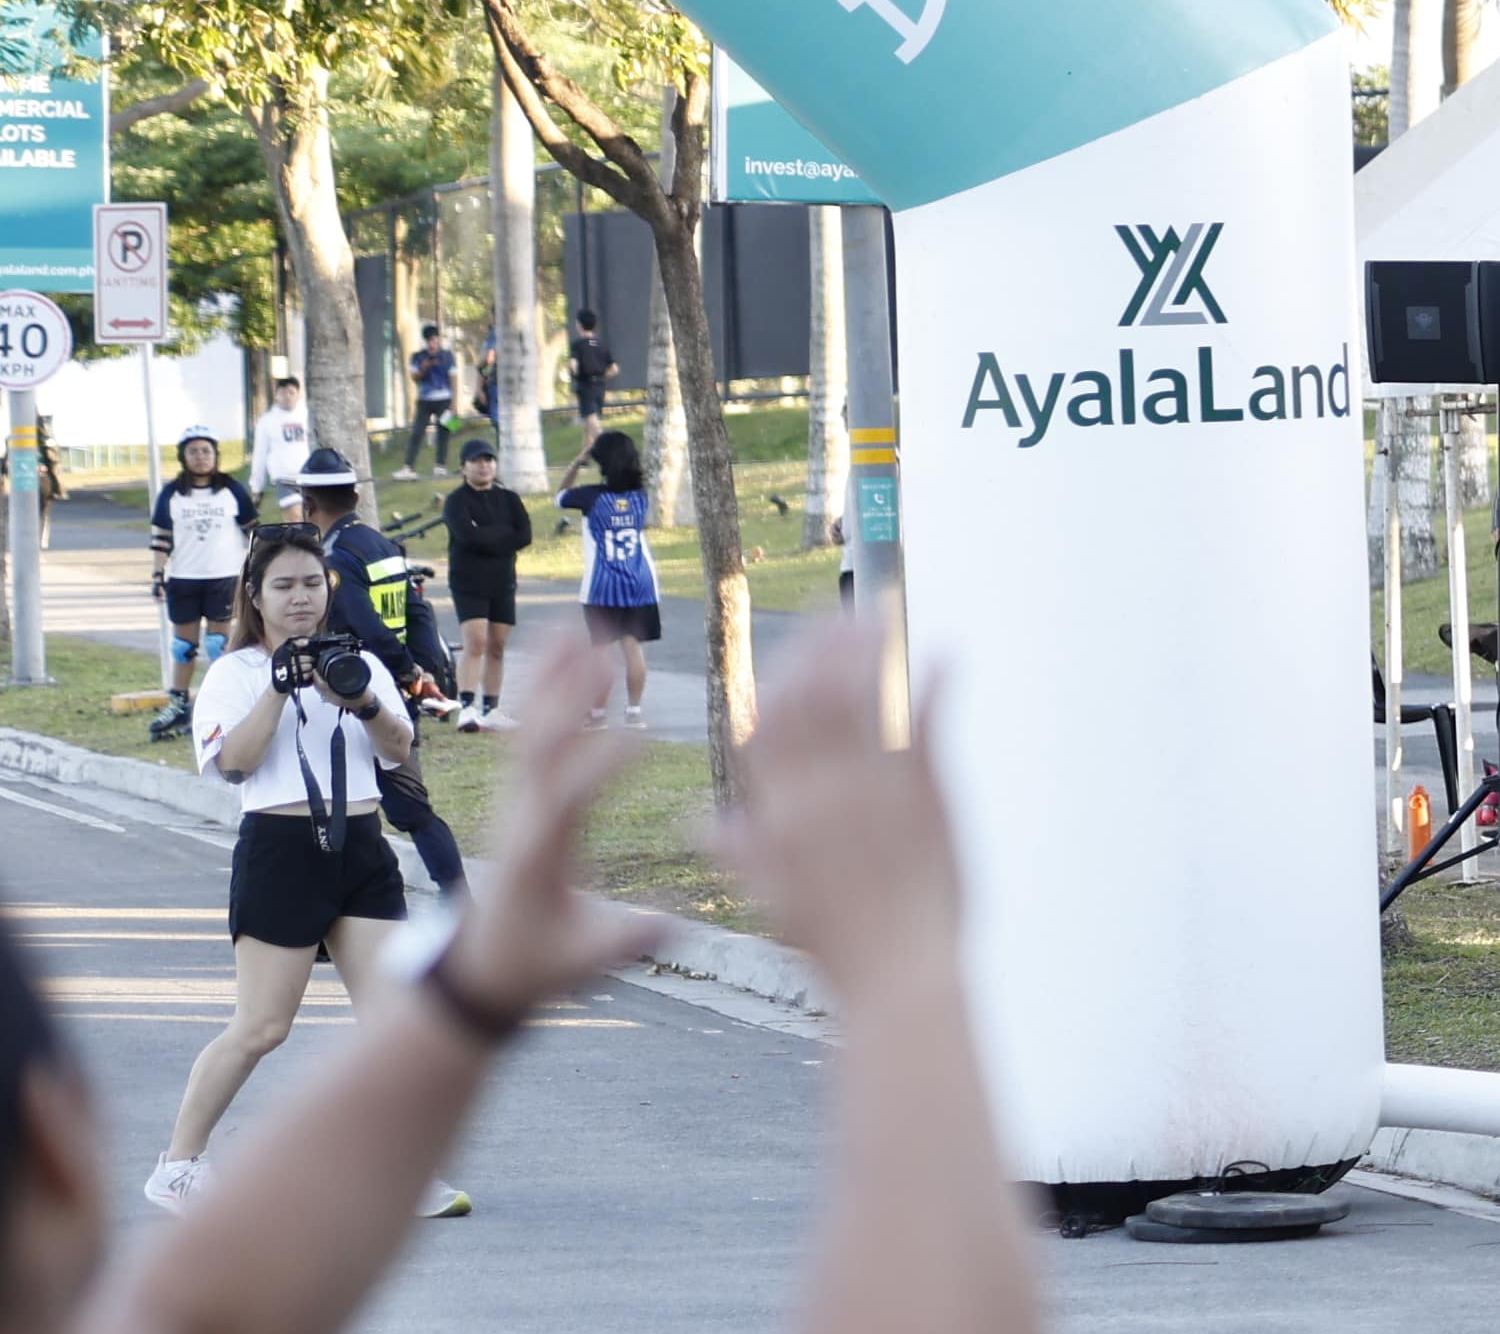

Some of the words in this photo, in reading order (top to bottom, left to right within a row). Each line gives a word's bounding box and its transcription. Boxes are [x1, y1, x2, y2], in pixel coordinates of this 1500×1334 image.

[0, 123, 47, 143] OTS
[744, 156, 861, 181] invest@aya
[961, 342, 1351, 448] AyalaLand
[605, 528, 638, 562] 13
